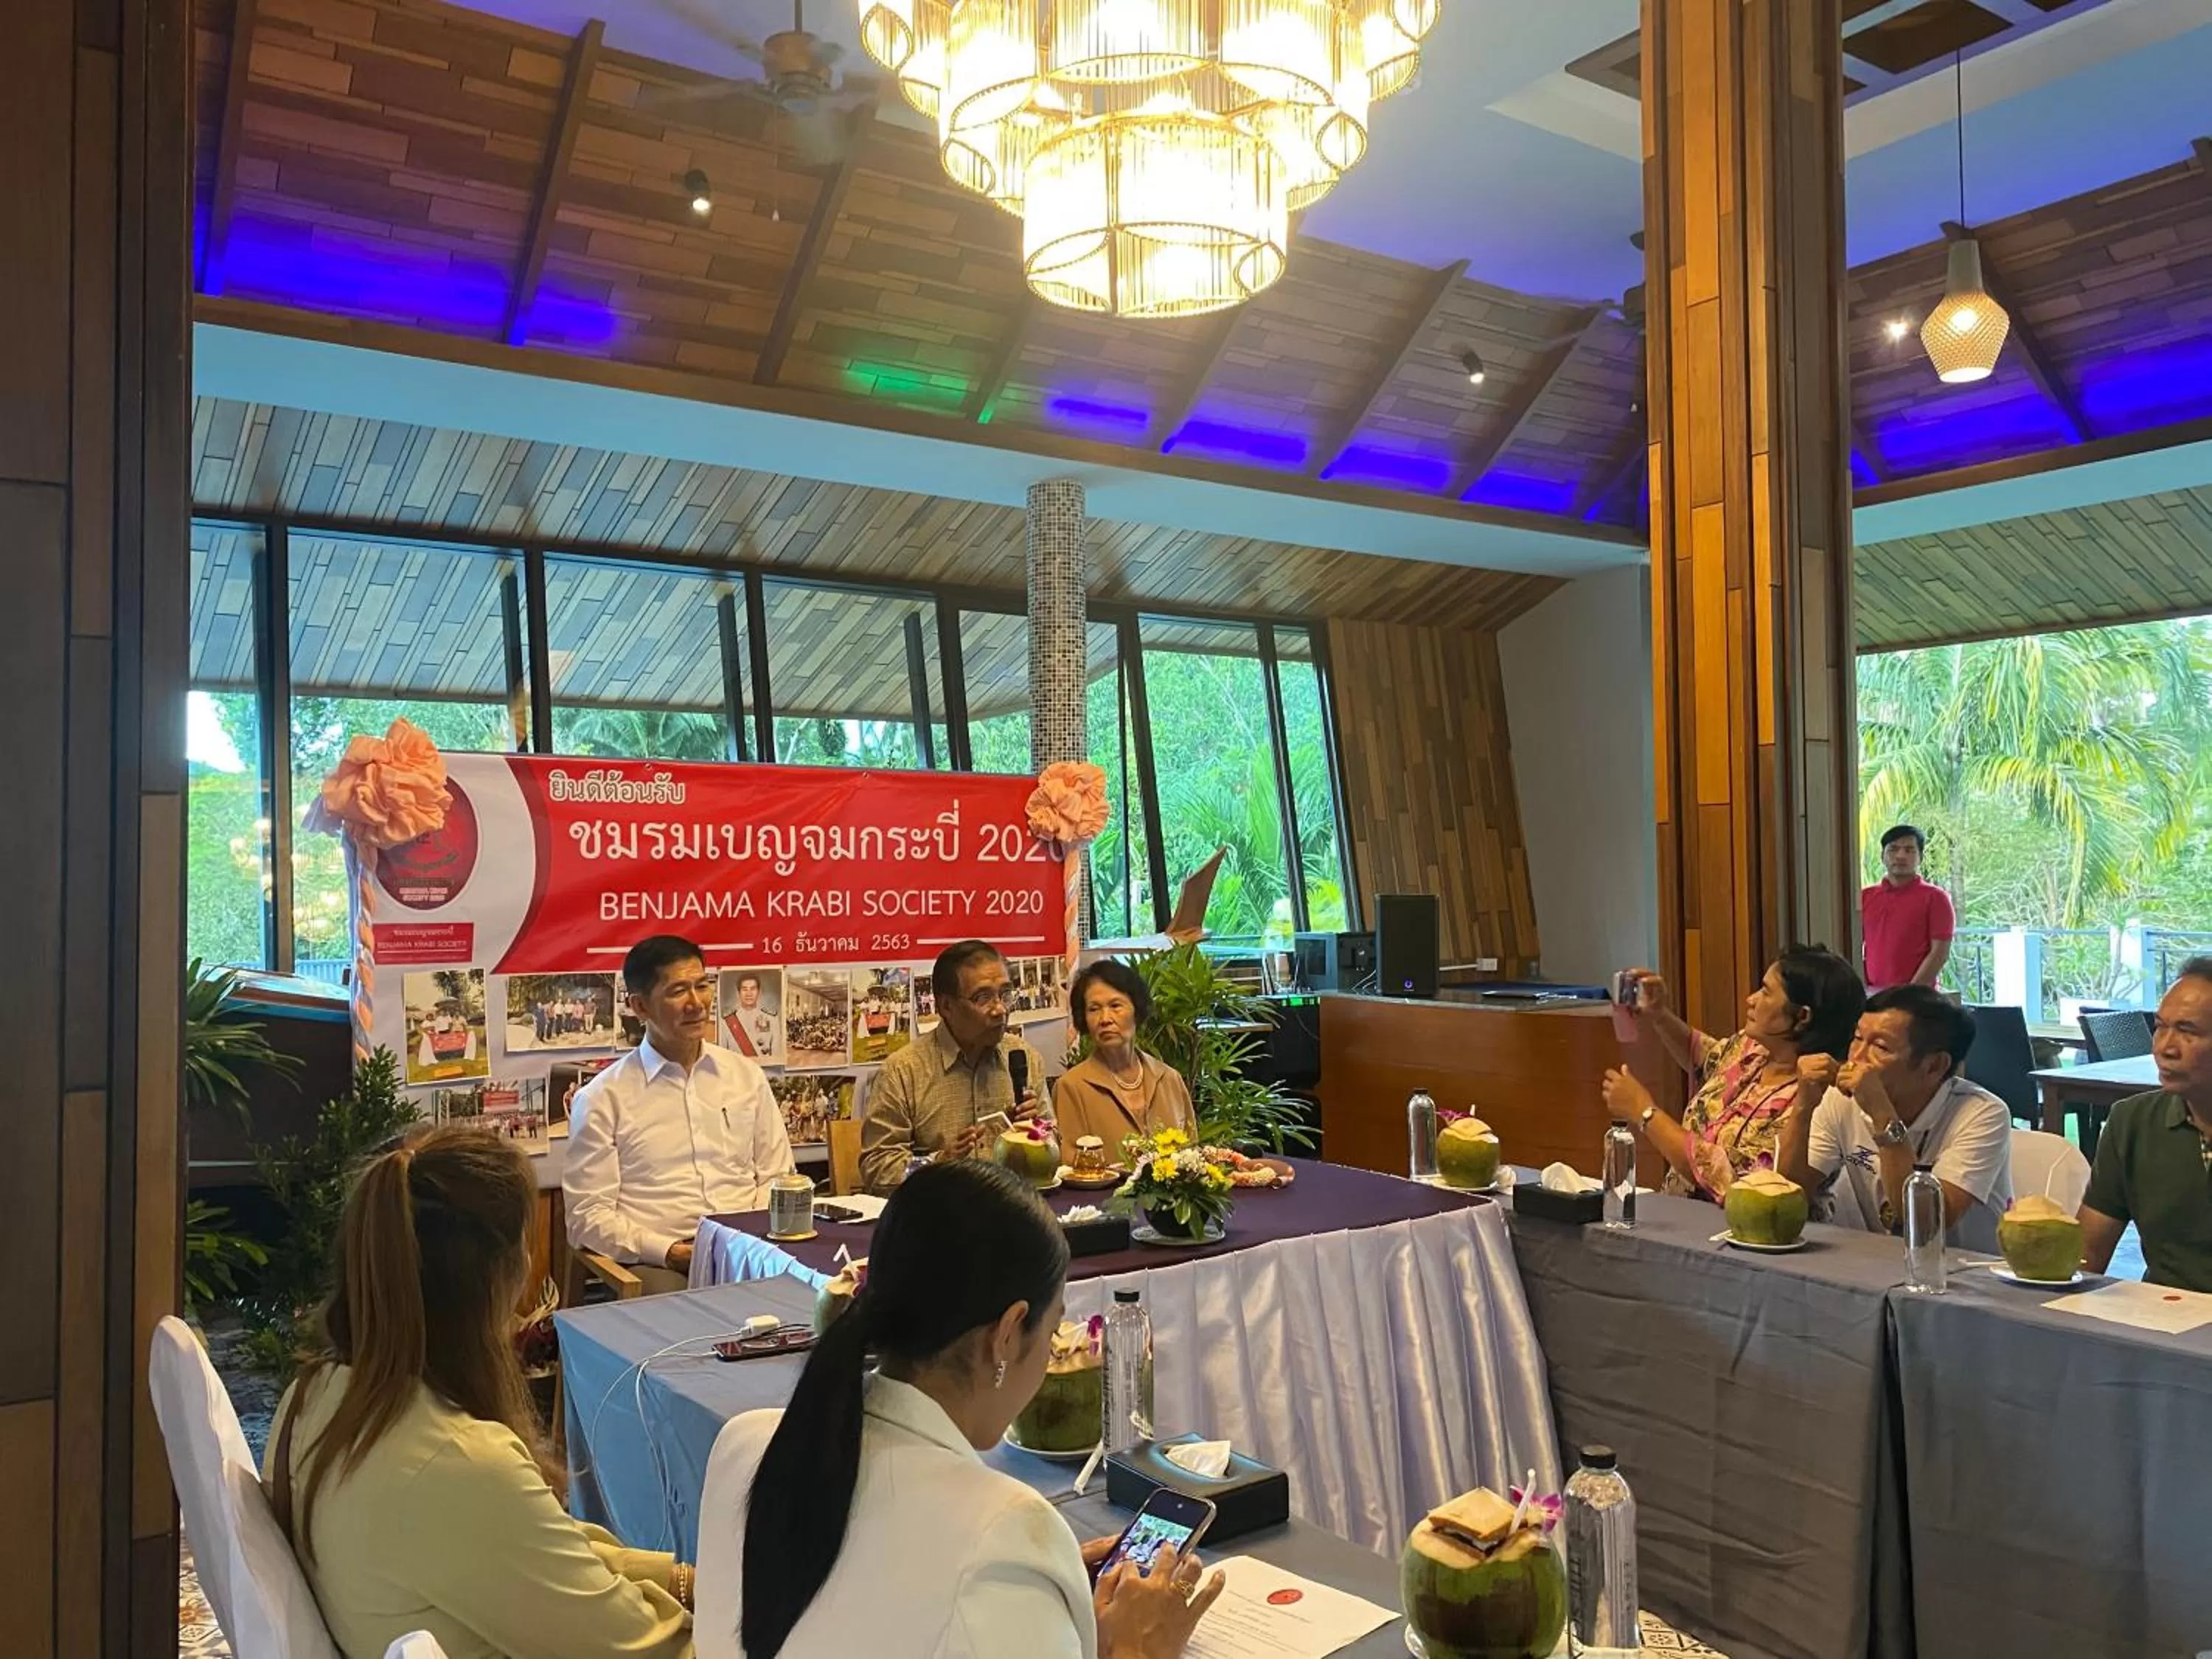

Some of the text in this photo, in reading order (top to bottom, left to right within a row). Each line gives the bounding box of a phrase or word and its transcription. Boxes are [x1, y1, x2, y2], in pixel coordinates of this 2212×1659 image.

[549, 768, 686, 804] ยินดีต้อนรับ
[568, 799, 960, 877] ชมรมเบญจมกระปี่
[599, 889, 1044, 922] BENJAMA KRABI SOCIETY 2020
[762, 931, 910, 953] 16 ธันวาคม 2563
